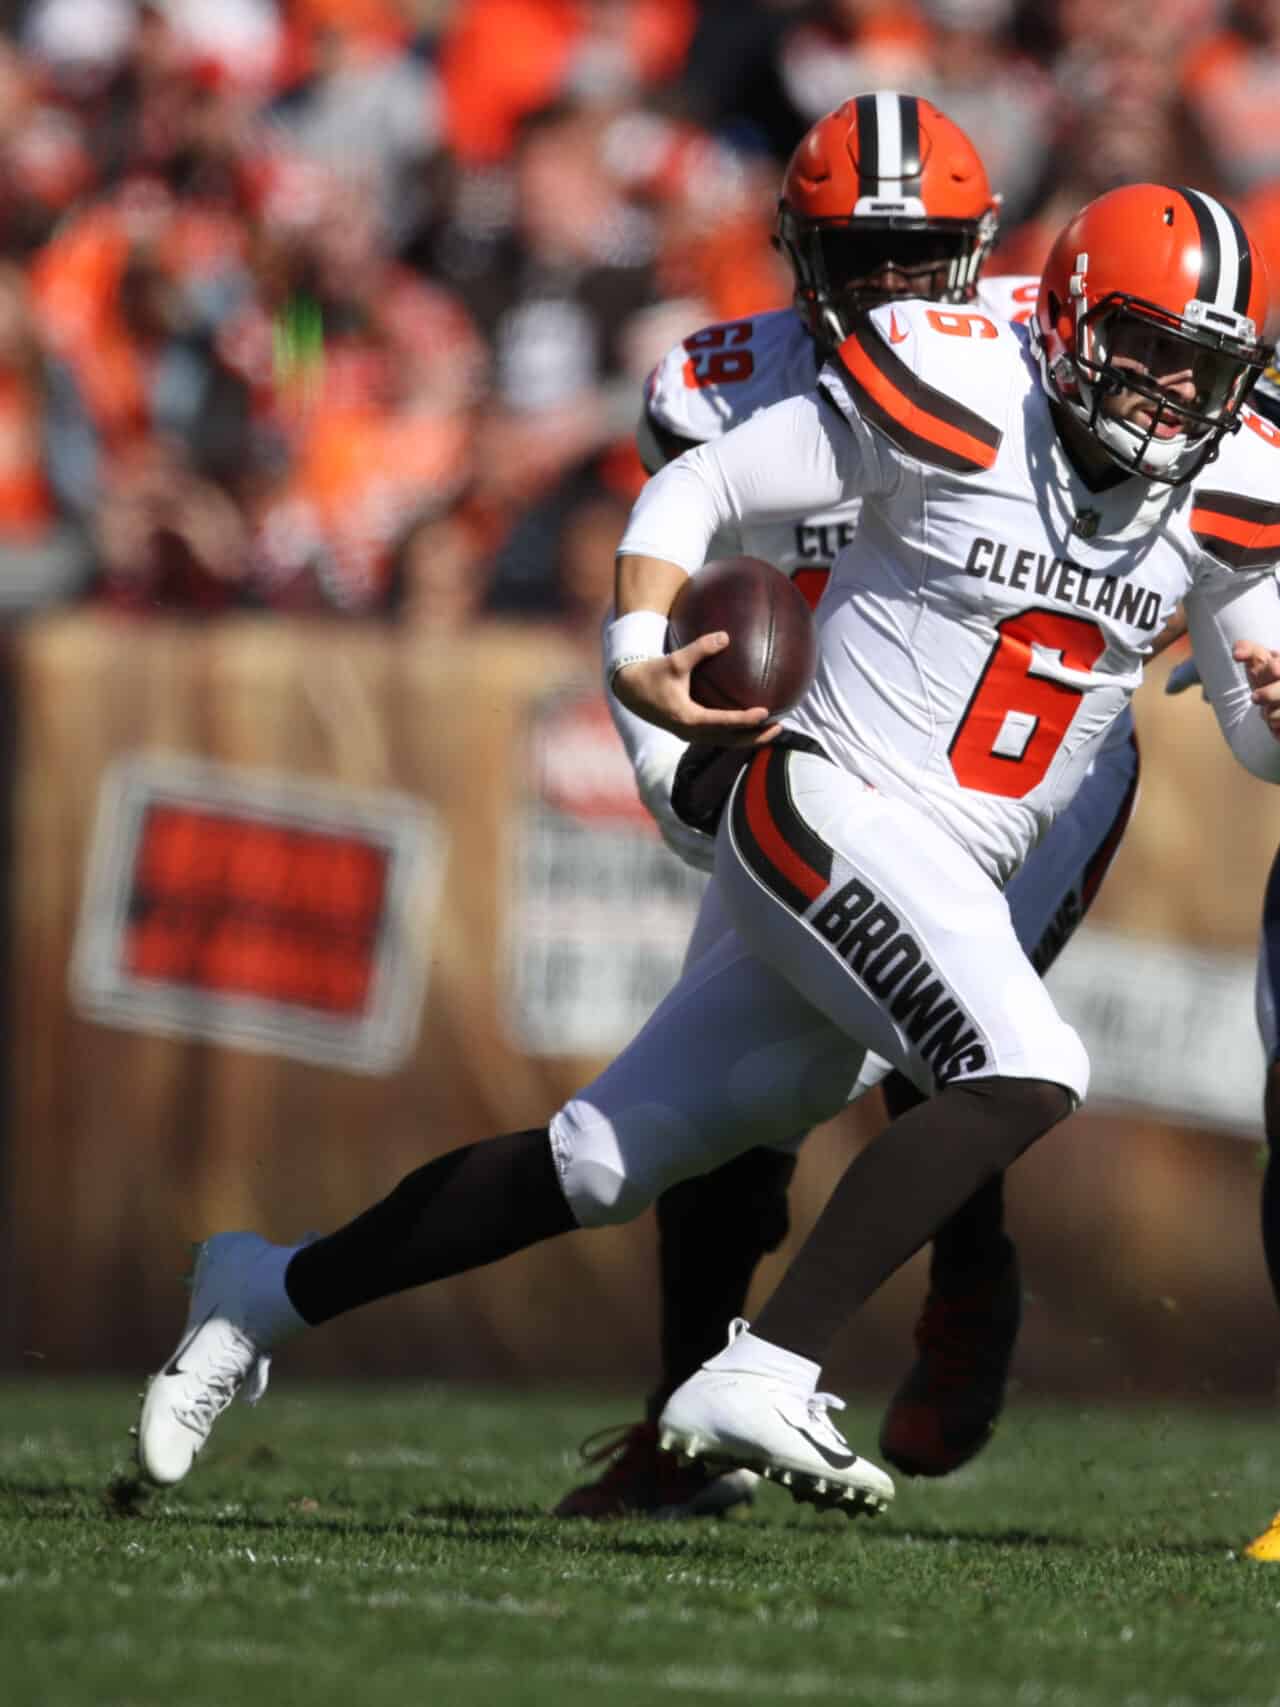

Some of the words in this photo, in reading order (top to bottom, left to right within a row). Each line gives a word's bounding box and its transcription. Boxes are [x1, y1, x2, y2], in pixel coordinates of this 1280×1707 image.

[682, 321, 754, 390] 69
[926, 309, 999, 340] 6
[964, 536, 1163, 632] CLEVELAND
[945, 605, 1108, 800] 6
[809, 877, 987, 1092] BROWNS
